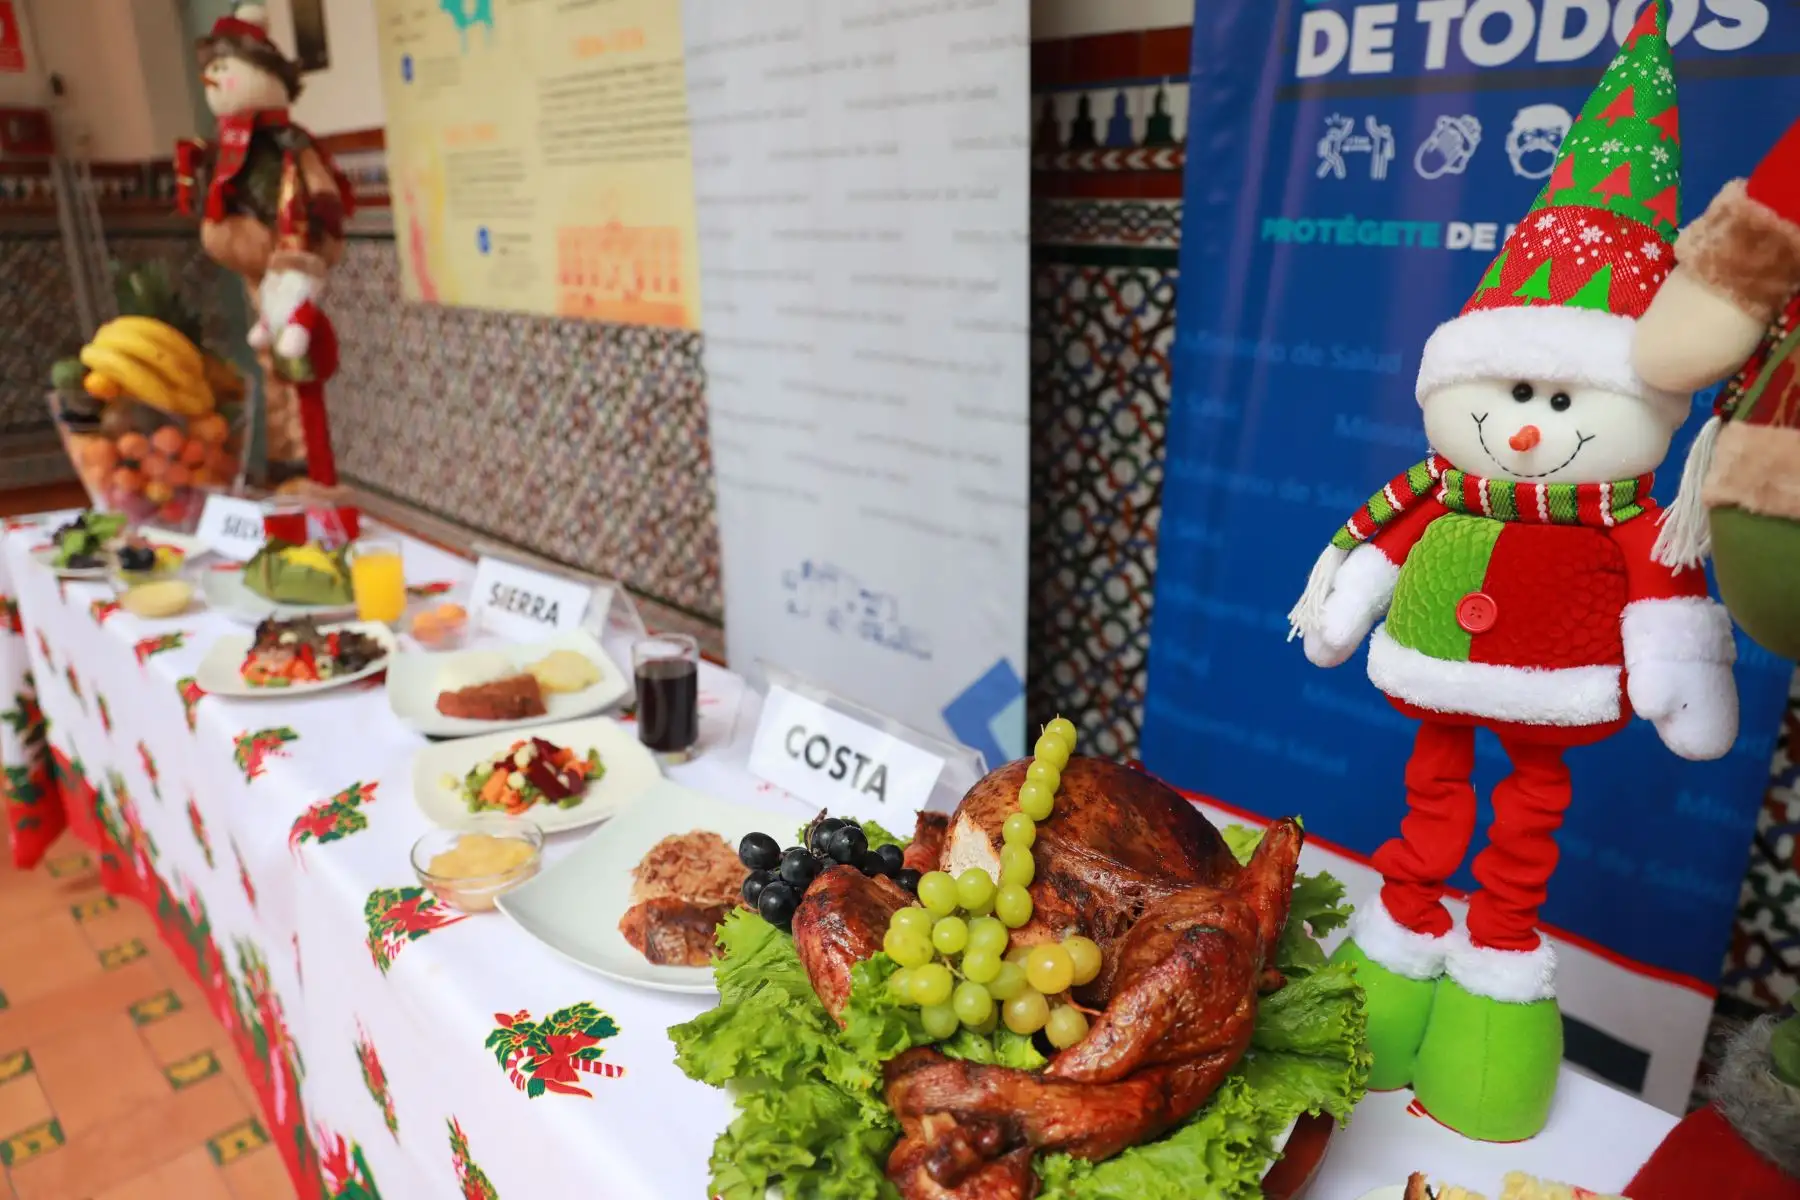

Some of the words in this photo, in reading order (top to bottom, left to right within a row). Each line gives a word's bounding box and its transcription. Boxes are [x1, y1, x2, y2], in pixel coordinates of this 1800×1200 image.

[1295, 3, 1398, 78] DE
[1416, 0, 1770, 70] TODOS
[1261, 213, 1441, 248] PROTÉGETE
[1446, 222, 1498, 250] DE
[488, 580, 560, 629] SIERRA
[785, 724, 888, 804] COSTA
